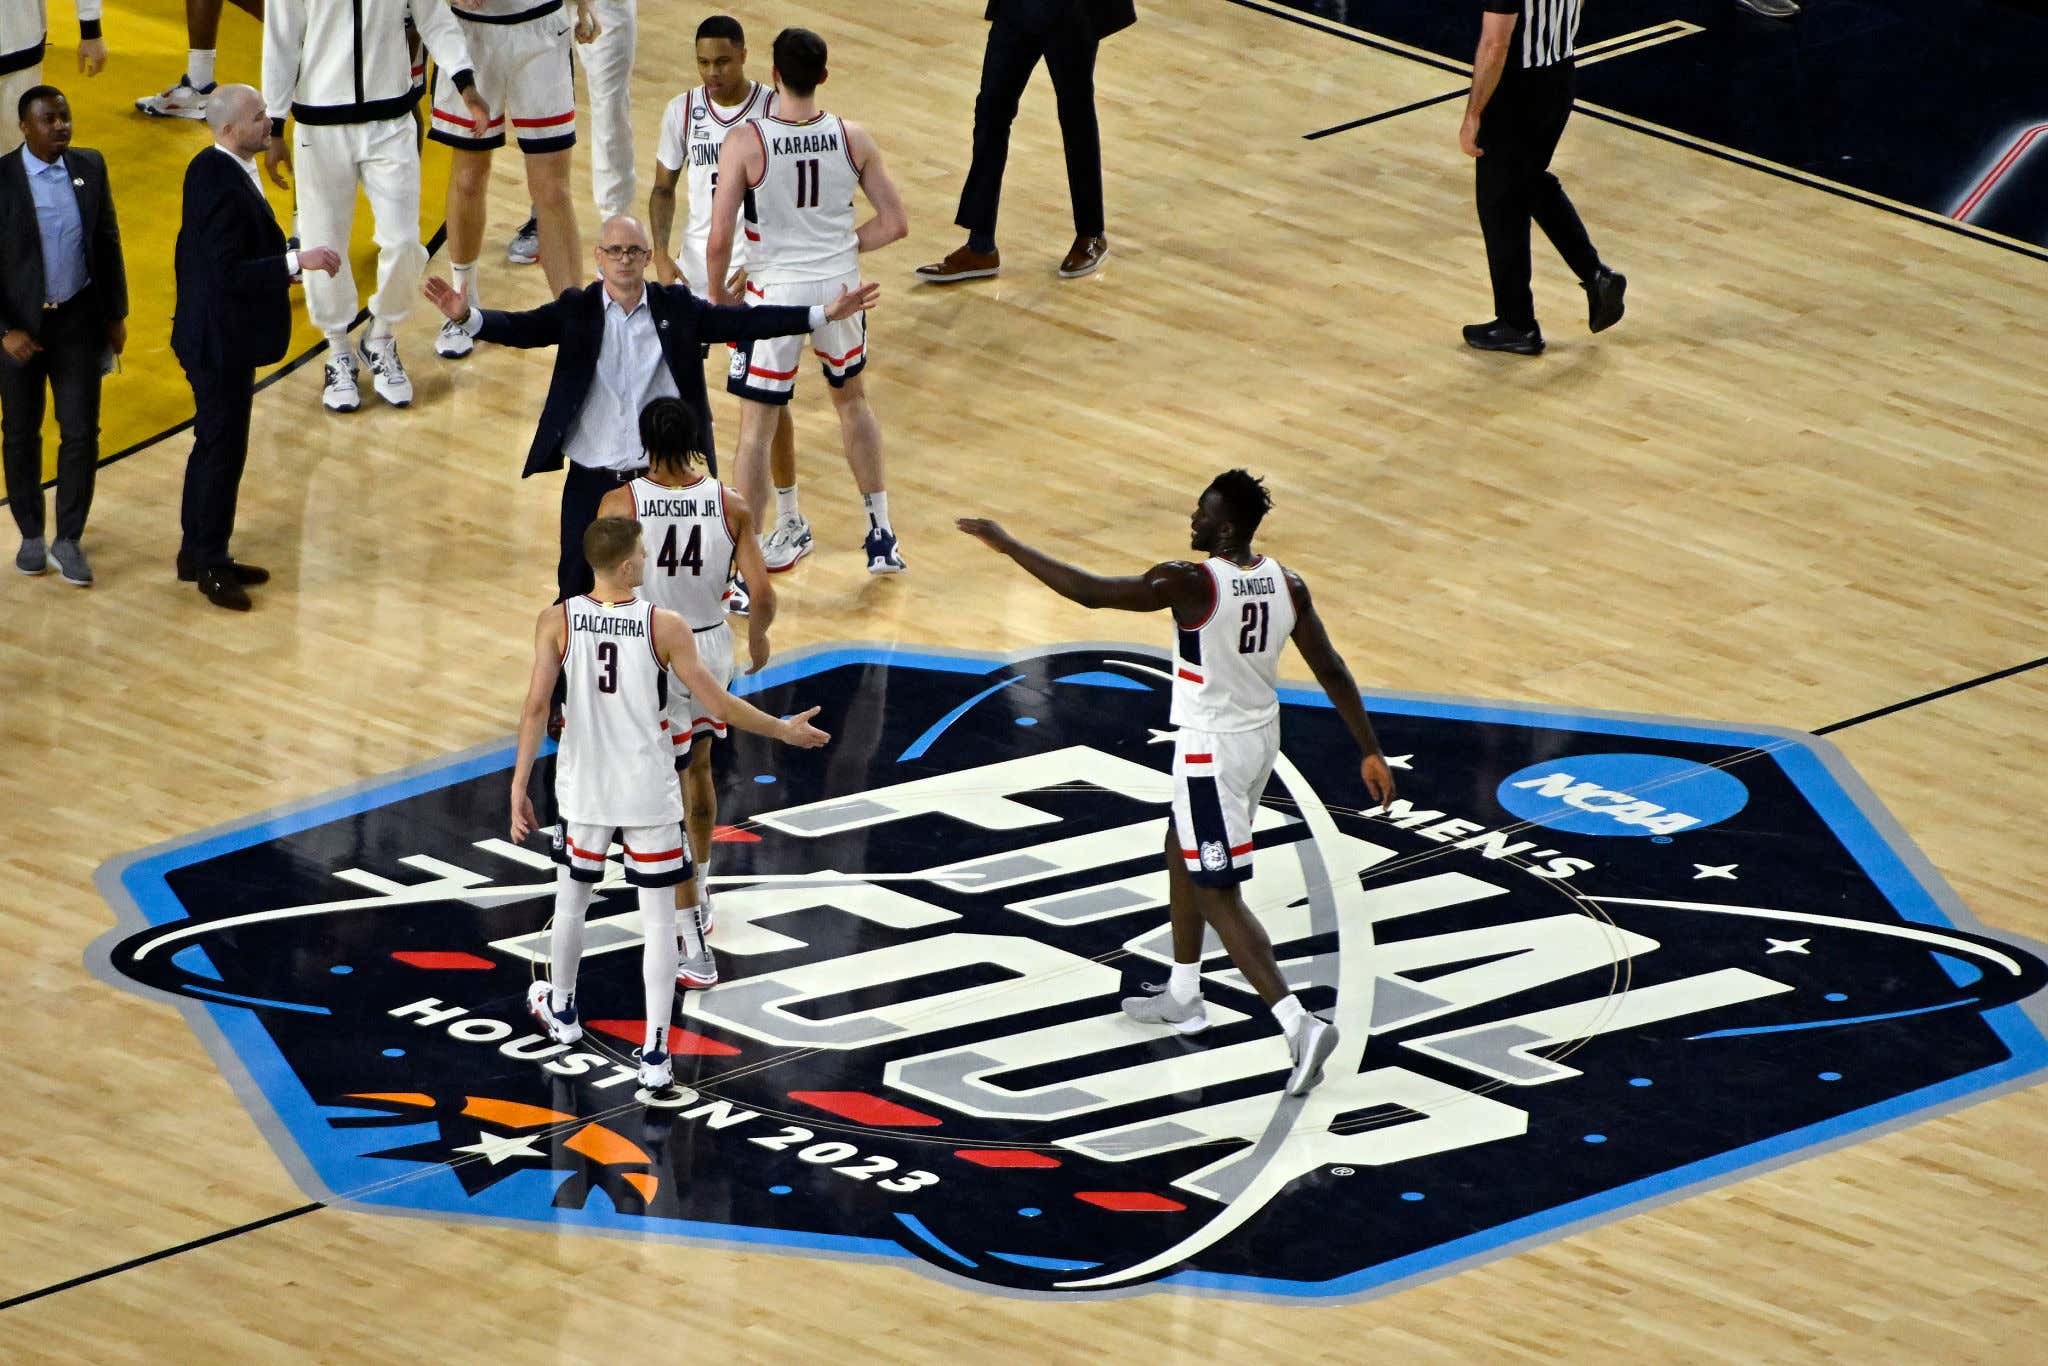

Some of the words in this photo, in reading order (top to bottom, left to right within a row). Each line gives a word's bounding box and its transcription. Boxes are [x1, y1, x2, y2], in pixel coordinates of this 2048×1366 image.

[773, 133, 838, 156] KARABAN
[795, 158, 820, 209] 11
[640, 499, 697, 518] JACKSON
[701, 499, 720, 518] JR.
[656, 523, 704, 577] 44
[1232, 576, 1276, 597] SANOGO
[573, 613, 645, 638] CALCATERRA
[1238, 601, 1269, 654] 21
[597, 641, 619, 694] 3
[1512, 772, 1702, 835] NCAA
[1358, 798, 1596, 879] MEN'S
[748, 744, 1796, 1084] FINAL
[387, 996, 760, 1130] HOUSTON
[747, 1125, 941, 1194] 2023
